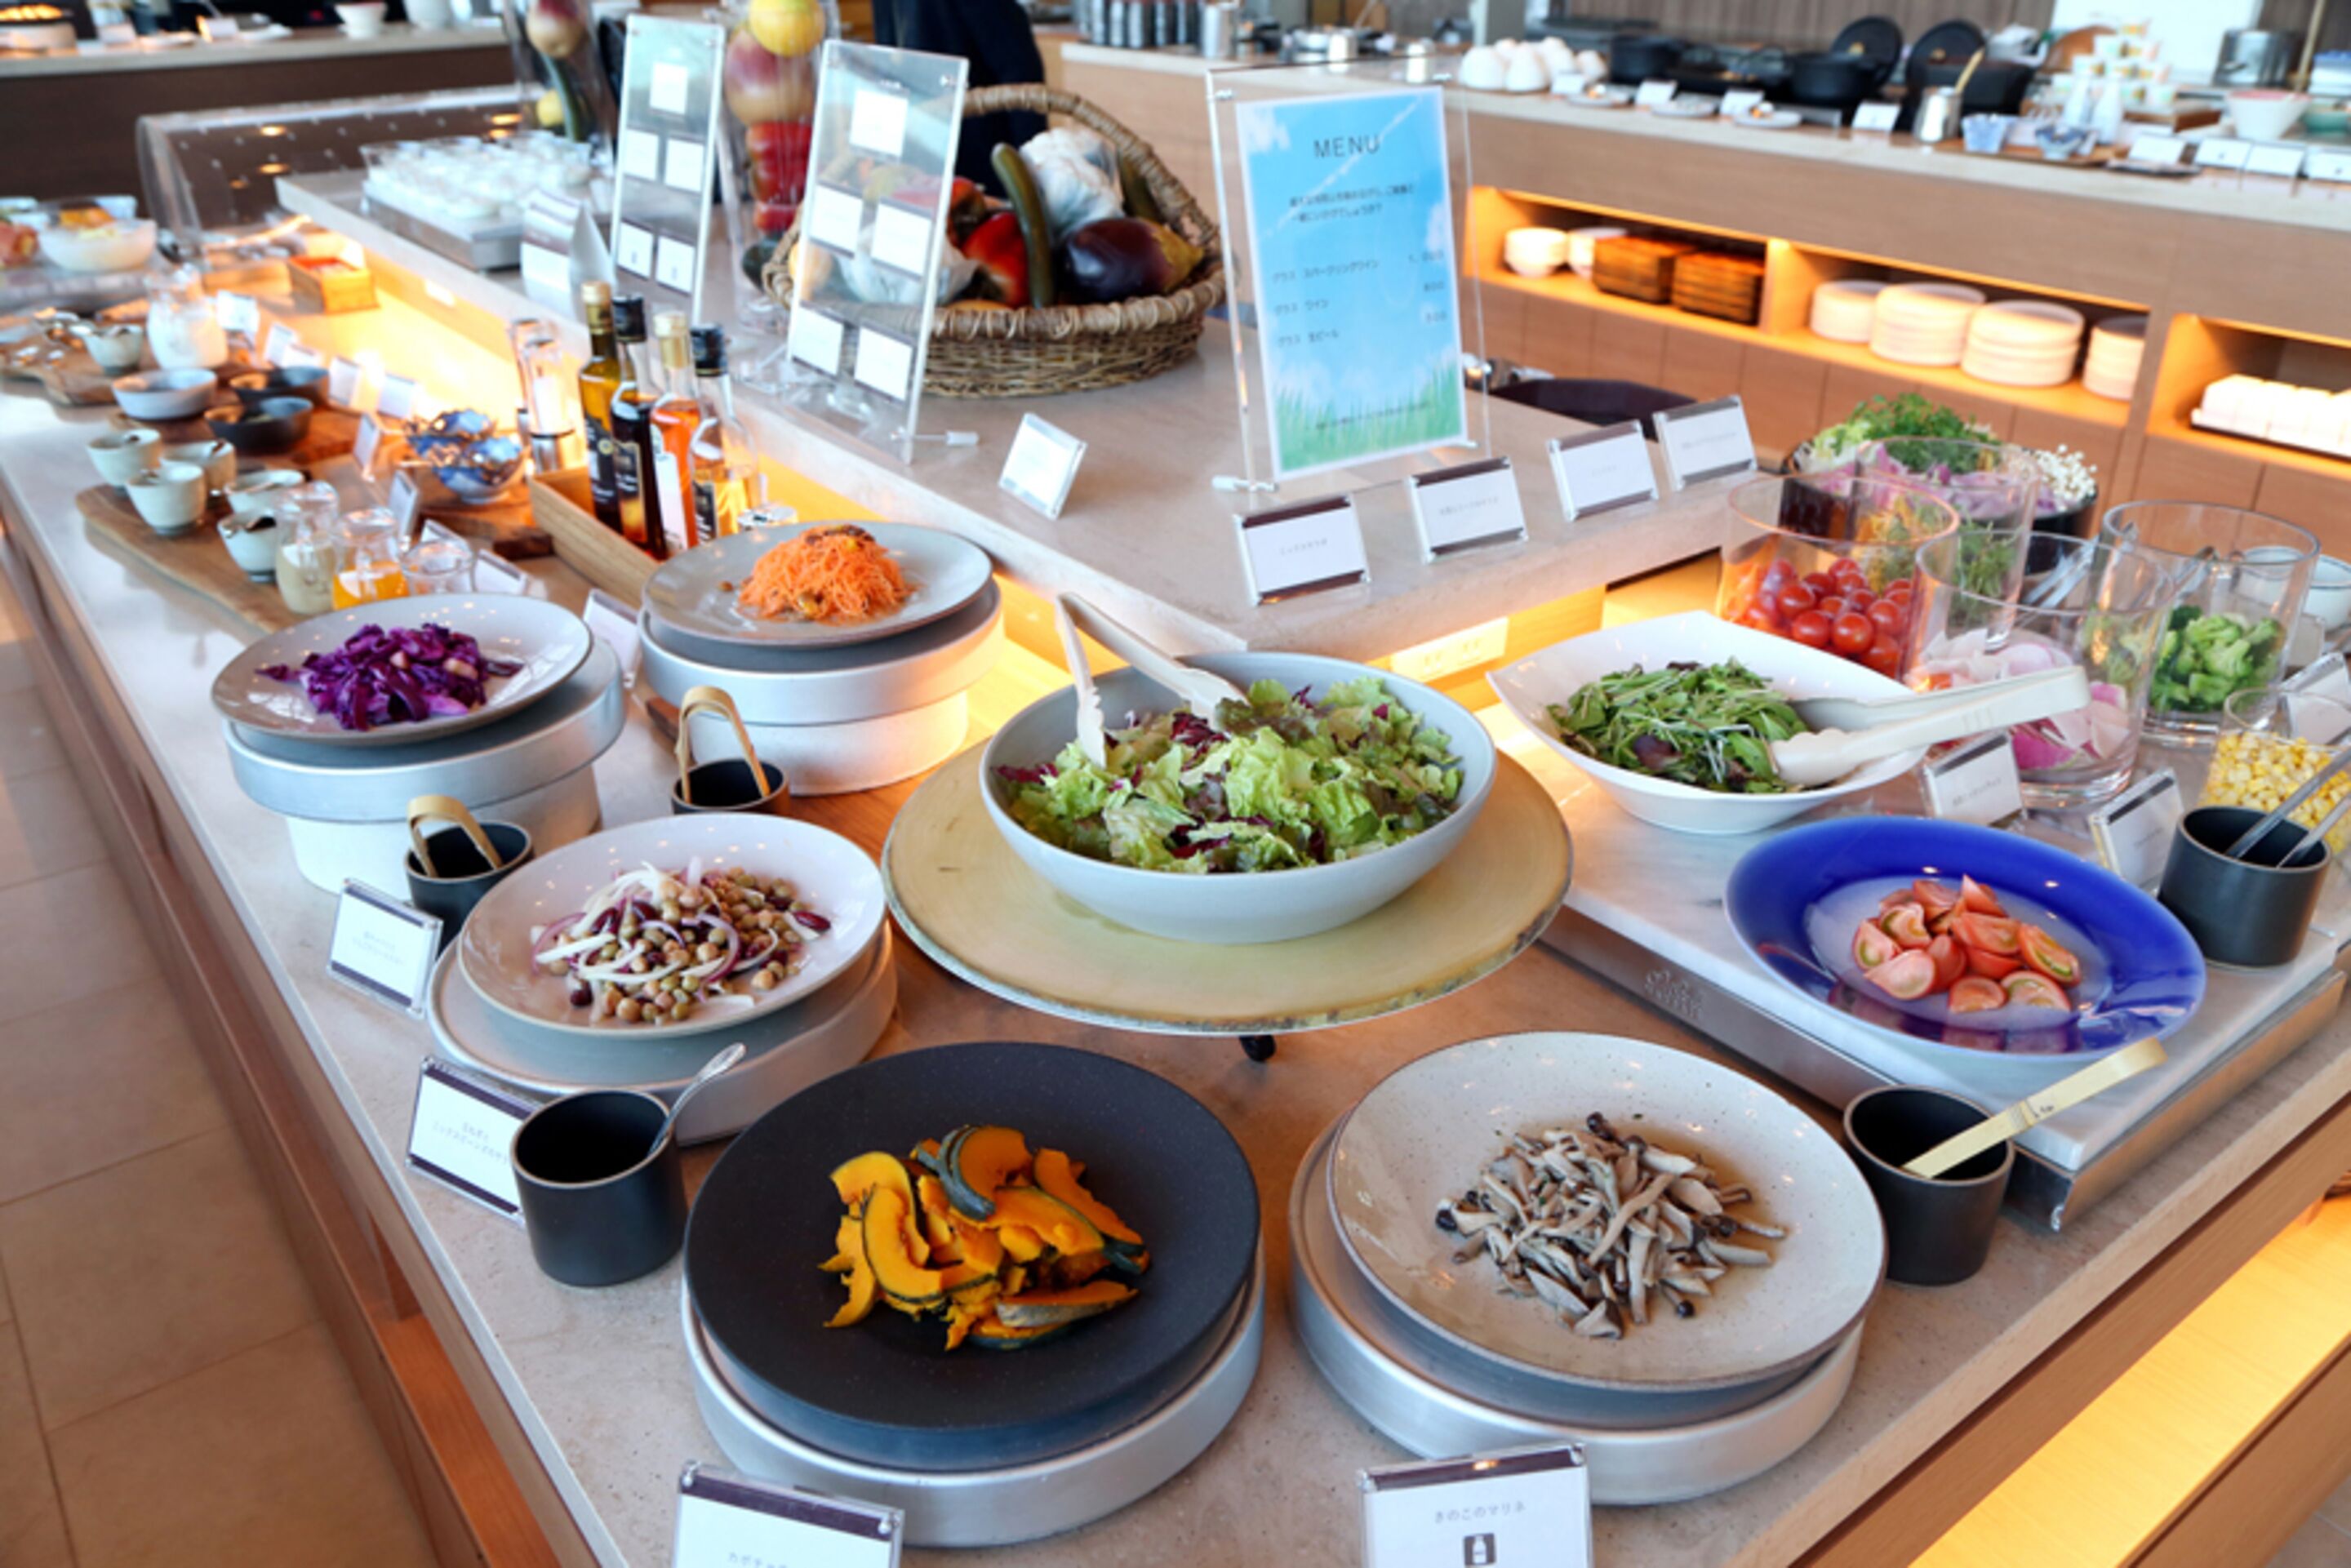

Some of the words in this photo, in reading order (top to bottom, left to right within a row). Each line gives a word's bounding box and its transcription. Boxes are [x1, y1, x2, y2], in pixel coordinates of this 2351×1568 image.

[1313, 134, 1381, 158] MENU
[1434, 1500, 1526, 1524] きのこのマリネ
